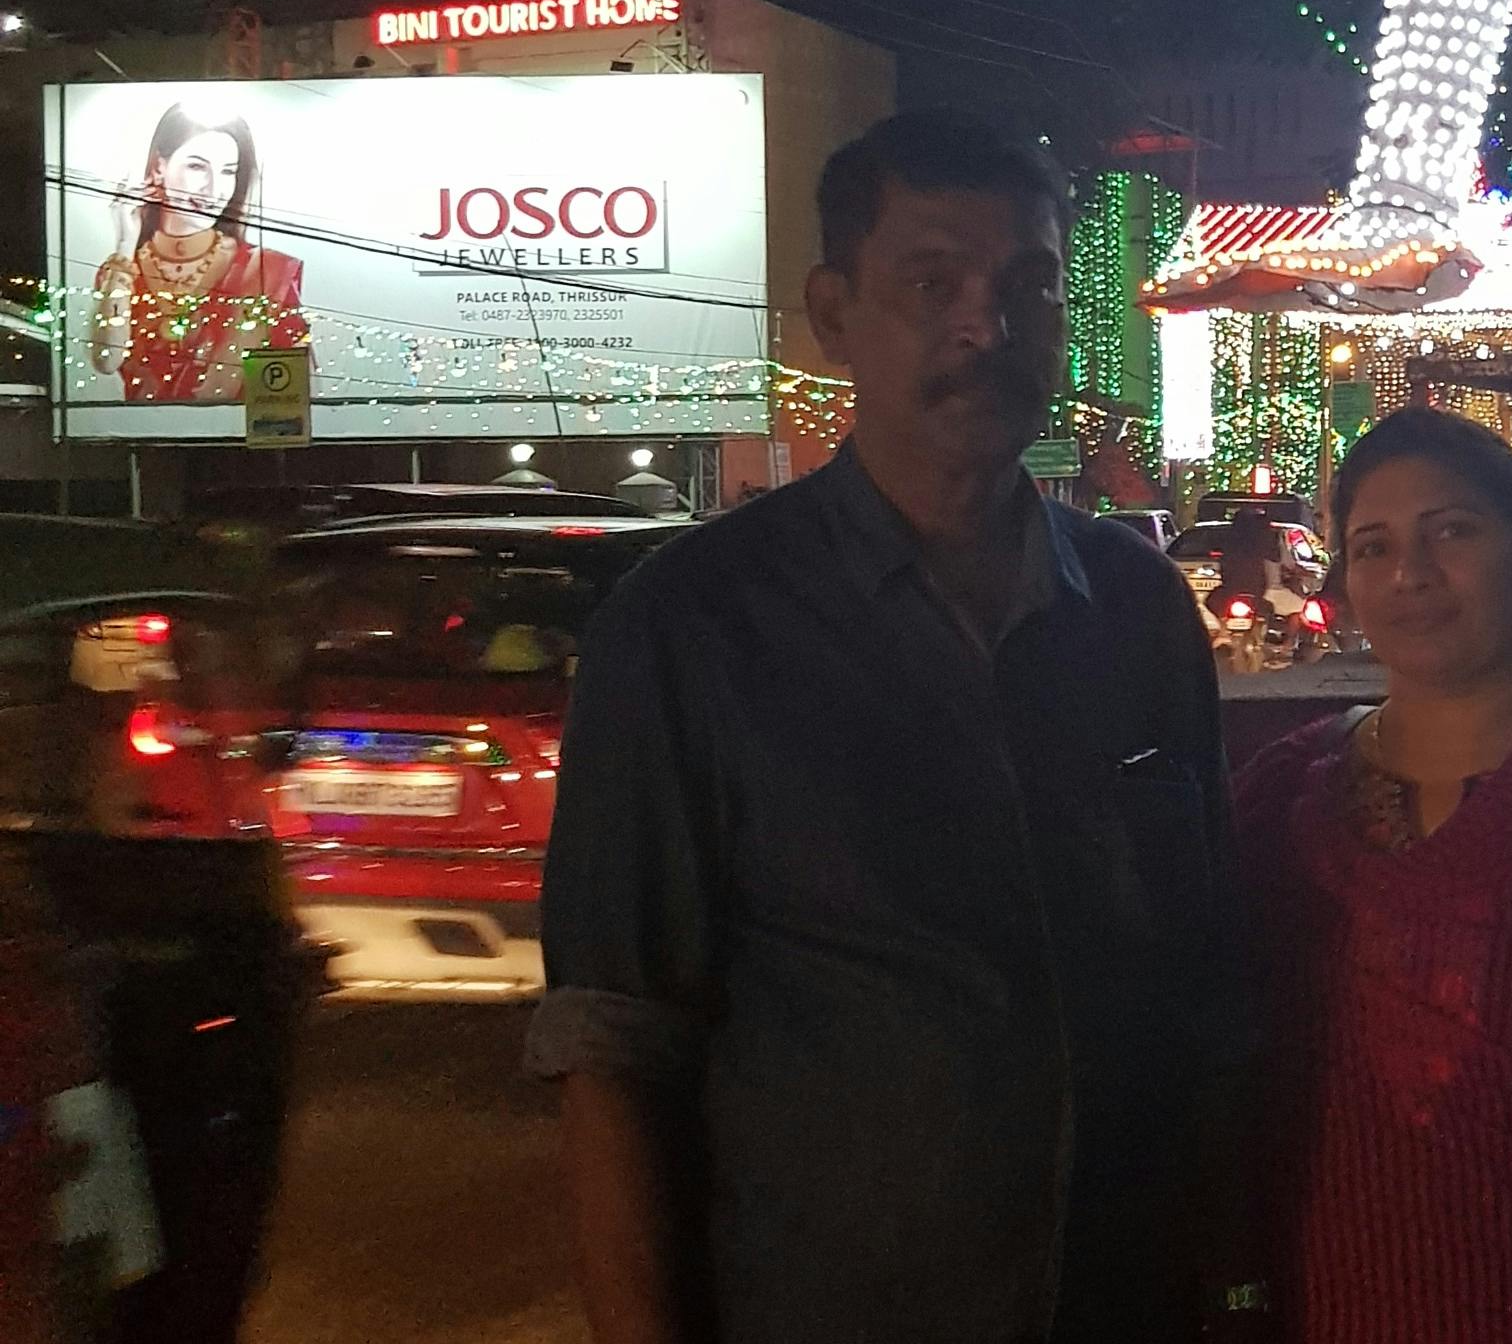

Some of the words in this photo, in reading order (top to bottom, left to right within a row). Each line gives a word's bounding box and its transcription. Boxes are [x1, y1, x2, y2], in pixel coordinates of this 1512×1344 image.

[379, 10, 438, 44] BINI
[420, 187, 657, 240] JOSCO
[440, 248, 639, 266] JEWELLERS
[457, 293, 507, 303] PALACE
[512, 292, 554, 304] ROAD,
[559, 291, 628, 303] THRISSUR
[460, 310, 477, 321] Tel:
[574, 309, 624, 320] 2325501
[269, 366, 283, 386] P
